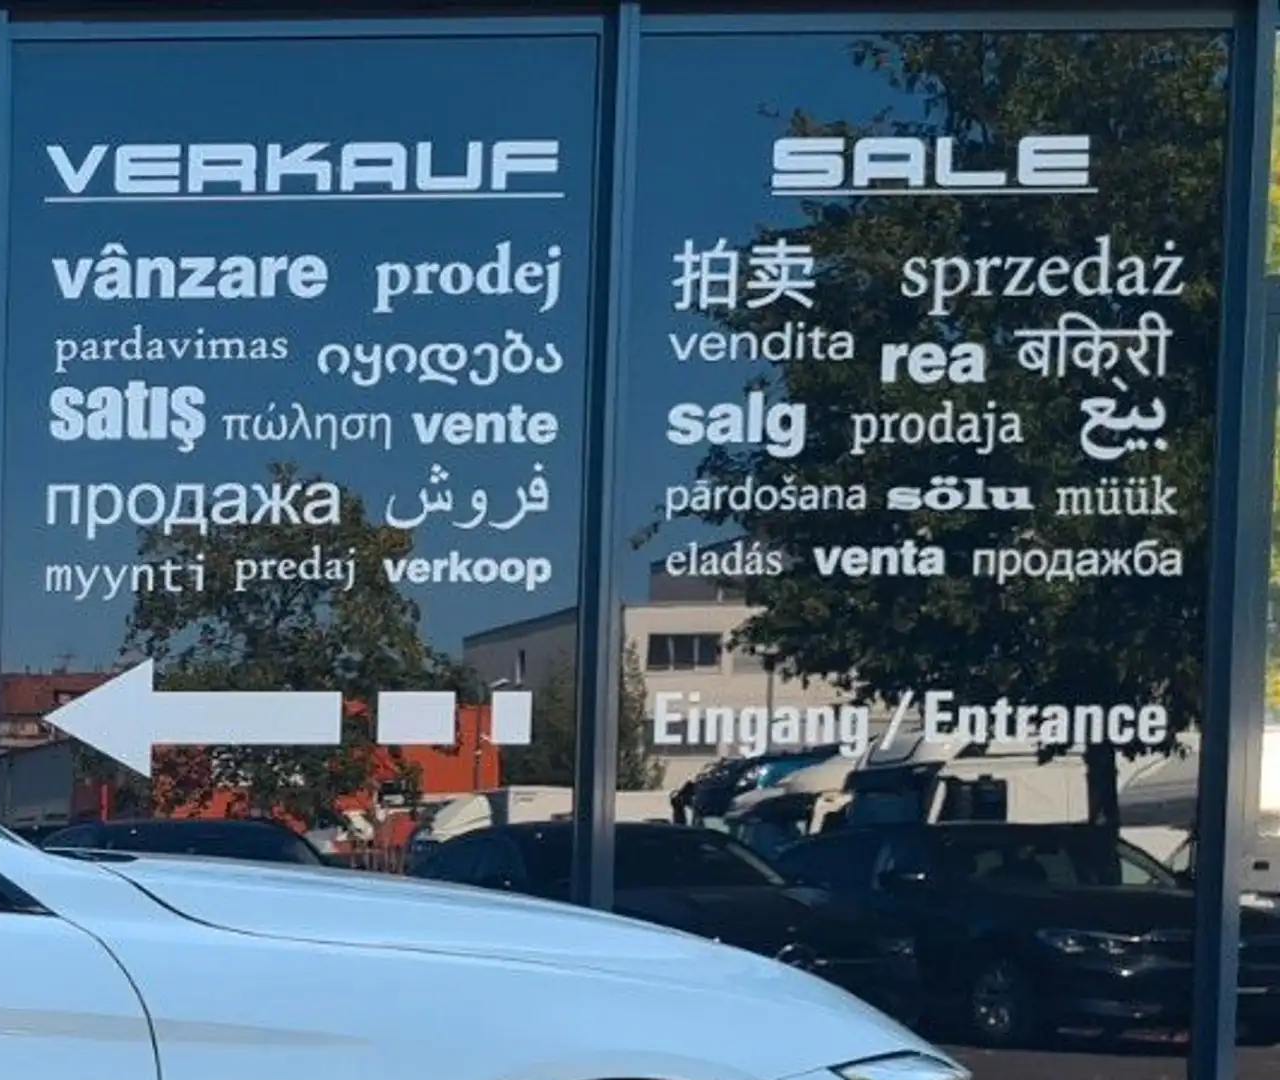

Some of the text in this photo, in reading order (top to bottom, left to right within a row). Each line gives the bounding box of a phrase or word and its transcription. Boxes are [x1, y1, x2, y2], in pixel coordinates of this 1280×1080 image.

[46, 140, 559, 193] VERKAUF
[772, 135, 1091, 187] SALE
[52, 241, 562, 313] vânzare prodej
[673, 238, 816, 311] 拍卖
[901, 235, 1185, 316] sprzedaż
[54, 324, 289, 373] pardavimas
[317, 329, 564, 386] იყიდება
[669, 321, 986, 384] vendita rea
[50, 380, 206, 453] satış
[222, 402, 392, 450] πώληση
[412, 405, 558, 445] vente
[666, 391, 1024, 458] salg prodaja
[46, 482, 341, 540] продажа
[665, 475, 1178, 520] pārdošana sölu müük
[45, 545, 552, 601] myynti predaj verkoop
[665, 539, 945, 577] eladás venta
[972, 540, 1183, 585] продажба
[653, 690, 1168, 758] Eingang / Entrance
